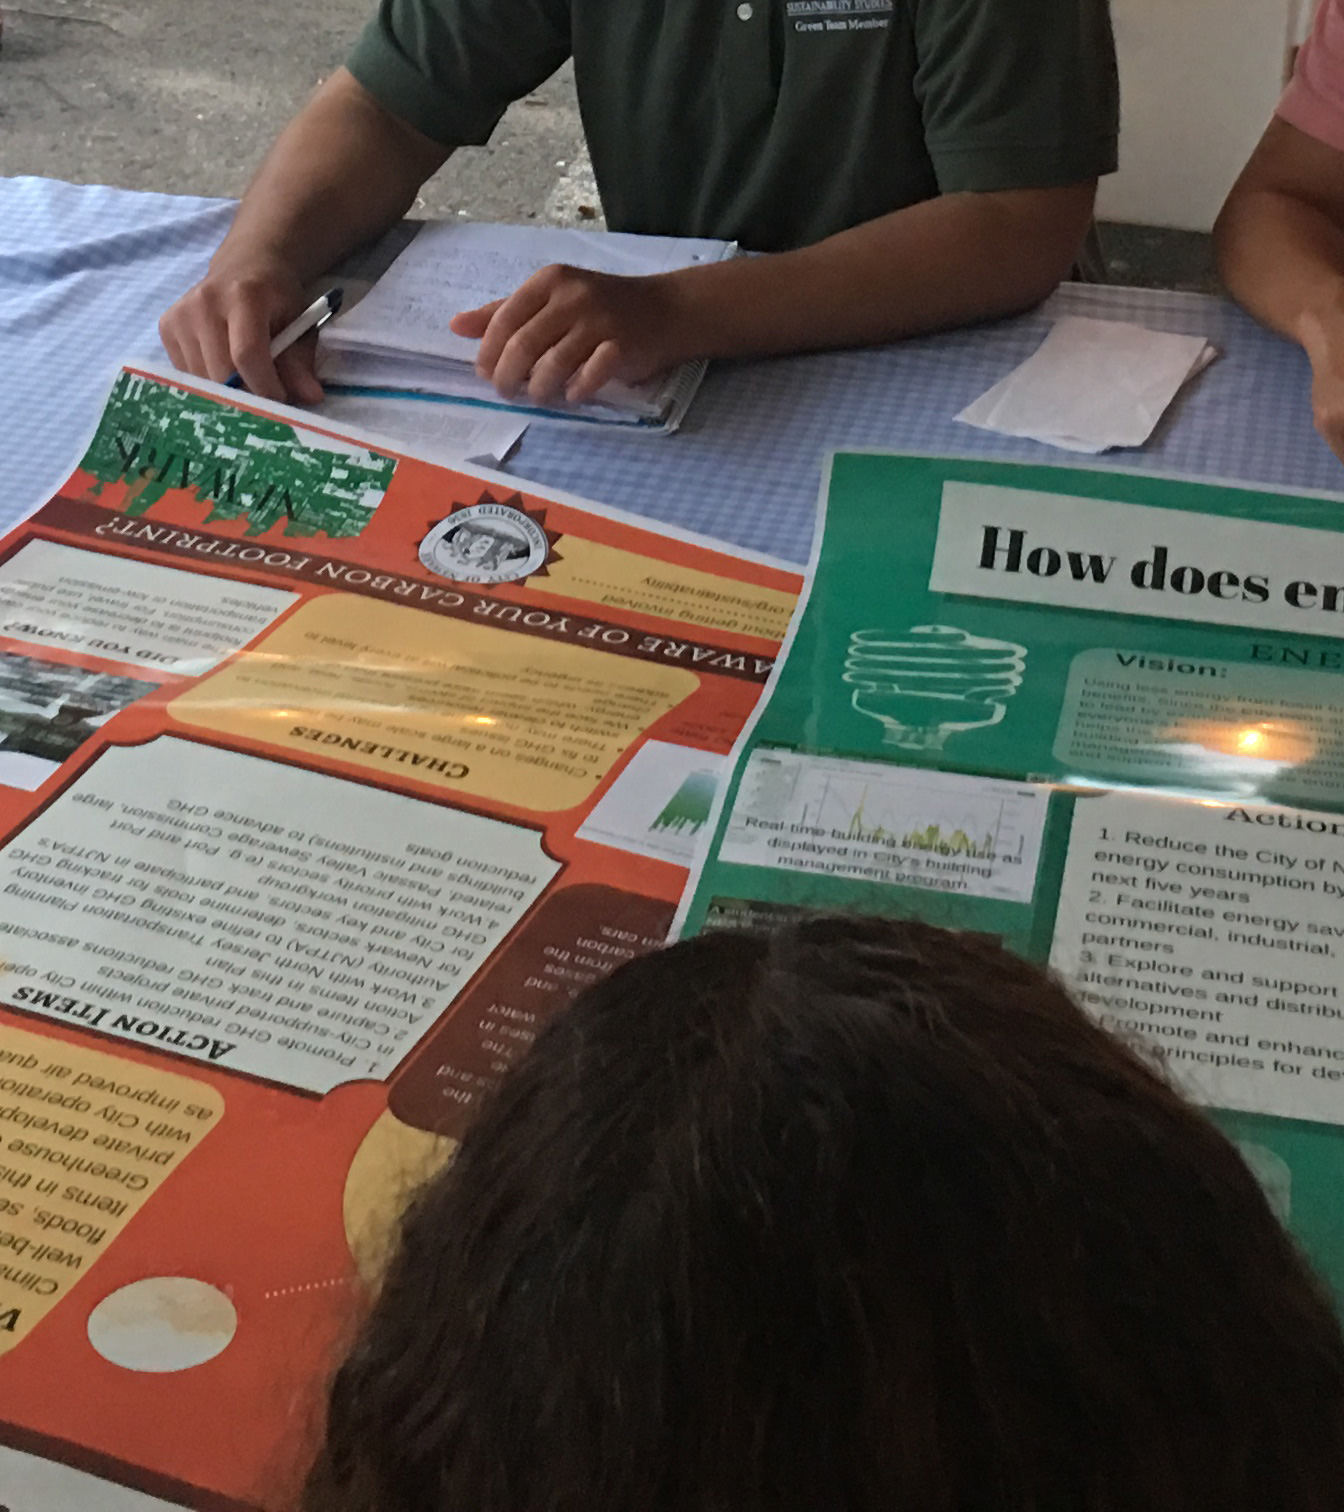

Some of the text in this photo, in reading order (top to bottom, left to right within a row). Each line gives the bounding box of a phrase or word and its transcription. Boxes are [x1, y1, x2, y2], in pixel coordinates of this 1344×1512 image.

[786, 0, 851, 12] SUSTAINABILITY
[795, 17, 889, 32] Green Team Member
[478, 506, 544, 550] INCORPORATED
[91, 516, 310, 573] FOOTPRINT?
[978, 525, 1116, 584] How
[1130, 544, 1270, 603] does
[314, 562, 466, 610] CARBON
[472, 597, 571, 636] YOUR
[600, 594, 674, 618] involved
[678, 609, 738, 629] getting
[578, 619, 631, 647] OF
[1125, 831, 1206, 854] Reduce
[1215, 844, 1248, 860] the
[1255, 850, 1296, 869] City
[1304, 857, 1325, 870] of
[1091, 871, 1249, 904] next five years
[1094, 851, 1168, 872] energy
[1176, 861, 1314, 892] consumption
[1116, 893, 1214, 918] Facilitate
[1222, 911, 1299, 932] energy
[38, 970, 78, 988] City
[78, 981, 134, 1003] within
[1108, 954, 1192, 977] Explore
[1201, 968, 1243, 983] and
[1252, 976, 1336, 998] support
[134, 997, 222, 1028] reduction
[223, 1022, 273, 1043] GHG
[275, 1036, 357, 1066] Promote
[39, 1063, 72, 1080] air
[70, 1071, 181, 1113] improved
[183, 1104, 214, 1120] as
[5, 1138, 150, 1191] Greenhouse
